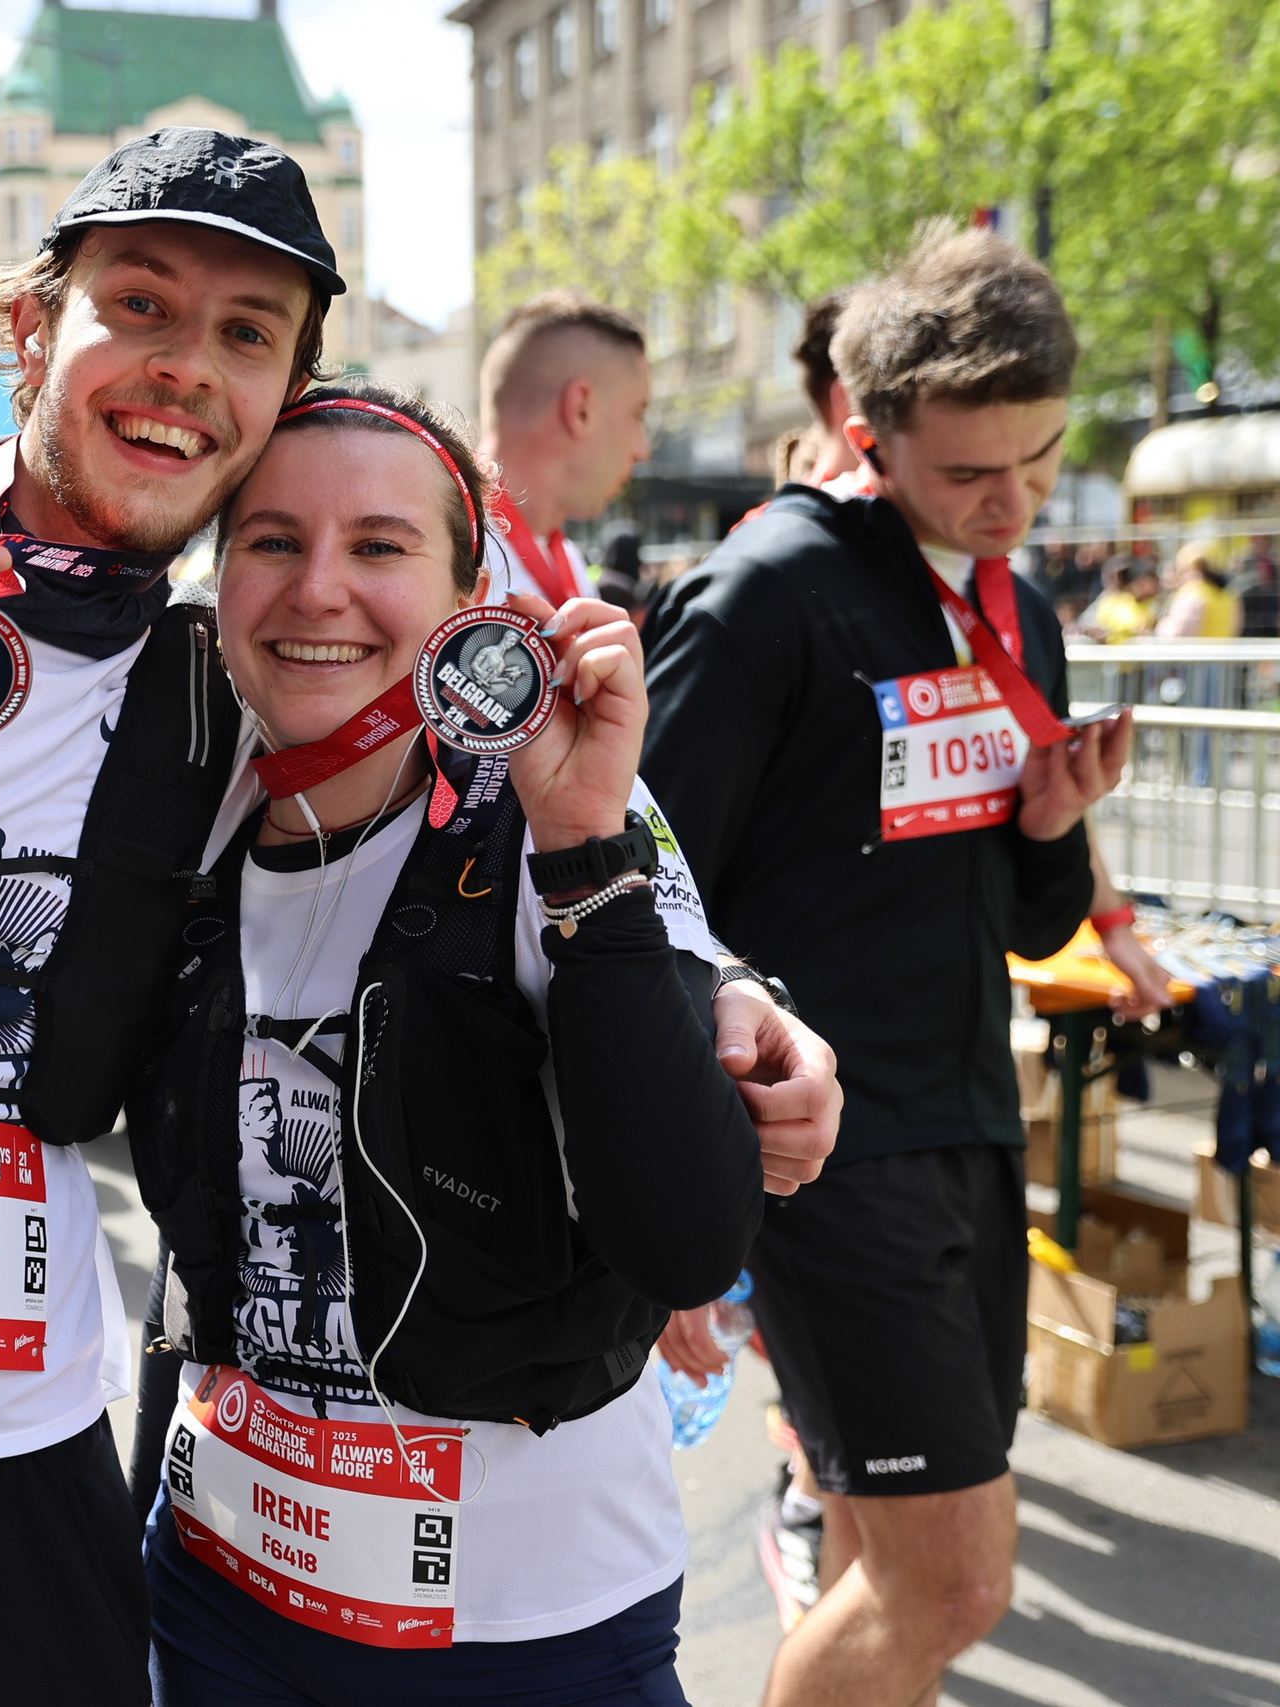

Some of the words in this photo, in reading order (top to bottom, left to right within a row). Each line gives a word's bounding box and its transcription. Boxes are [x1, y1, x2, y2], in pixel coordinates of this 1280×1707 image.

[366, 404, 396, 417] NIKE
[419, 429, 443, 449] NIKE
[455, 472, 470, 495] NIKE
[39, 547, 84, 562] BELGRADE
[25, 555, 74, 573] MARATHON
[69, 564, 97, 578] 2025
[119, 566, 153, 578] COMTRADE
[443, 610, 483, 634] BELGRADE
[484, 610, 529, 627] MARATHON
[9, 636, 26, 664] ALWAYS
[17, 665, 26, 687] MORE
[436, 661, 515, 730] BELGRADE
[362, 709, 388, 728] 21K
[443, 706, 472, 729] 21K
[882, 695, 901, 722] C
[438, 724, 458, 740] 2025
[527, 713, 545, 732] MORE
[353, 718, 401, 751] FINISHER
[928, 728, 1017, 780] 10319
[480, 754, 510, 804] LGRADE
[291, 1089, 342, 1119] ALWAS
[18, 1151, 28, 1167] 21
[18, 1167, 33, 1186] KM
[422, 1165, 502, 1213] EVADICT
[198, 1374, 219, 1403] B
[249, 1412, 308, 1453] BELGRADE
[265, 1409, 316, 1437] COMTRADE
[332, 1431, 358, 1441] 2025
[248, 1428, 316, 1470] MARATHON
[331, 1444, 394, 1465] ALWAYS
[409, 1450, 427, 1467] 21
[330, 1460, 374, 1480] MORE
[409, 1467, 436, 1485] KM
[253, 1481, 331, 1543] IRENE
[216, 1545, 239, 1567] POWER
[261, 1531, 318, 1574] F6418
[306, 1598, 329, 1613] SAVA
[397, 1617, 435, 1634] Wellness
